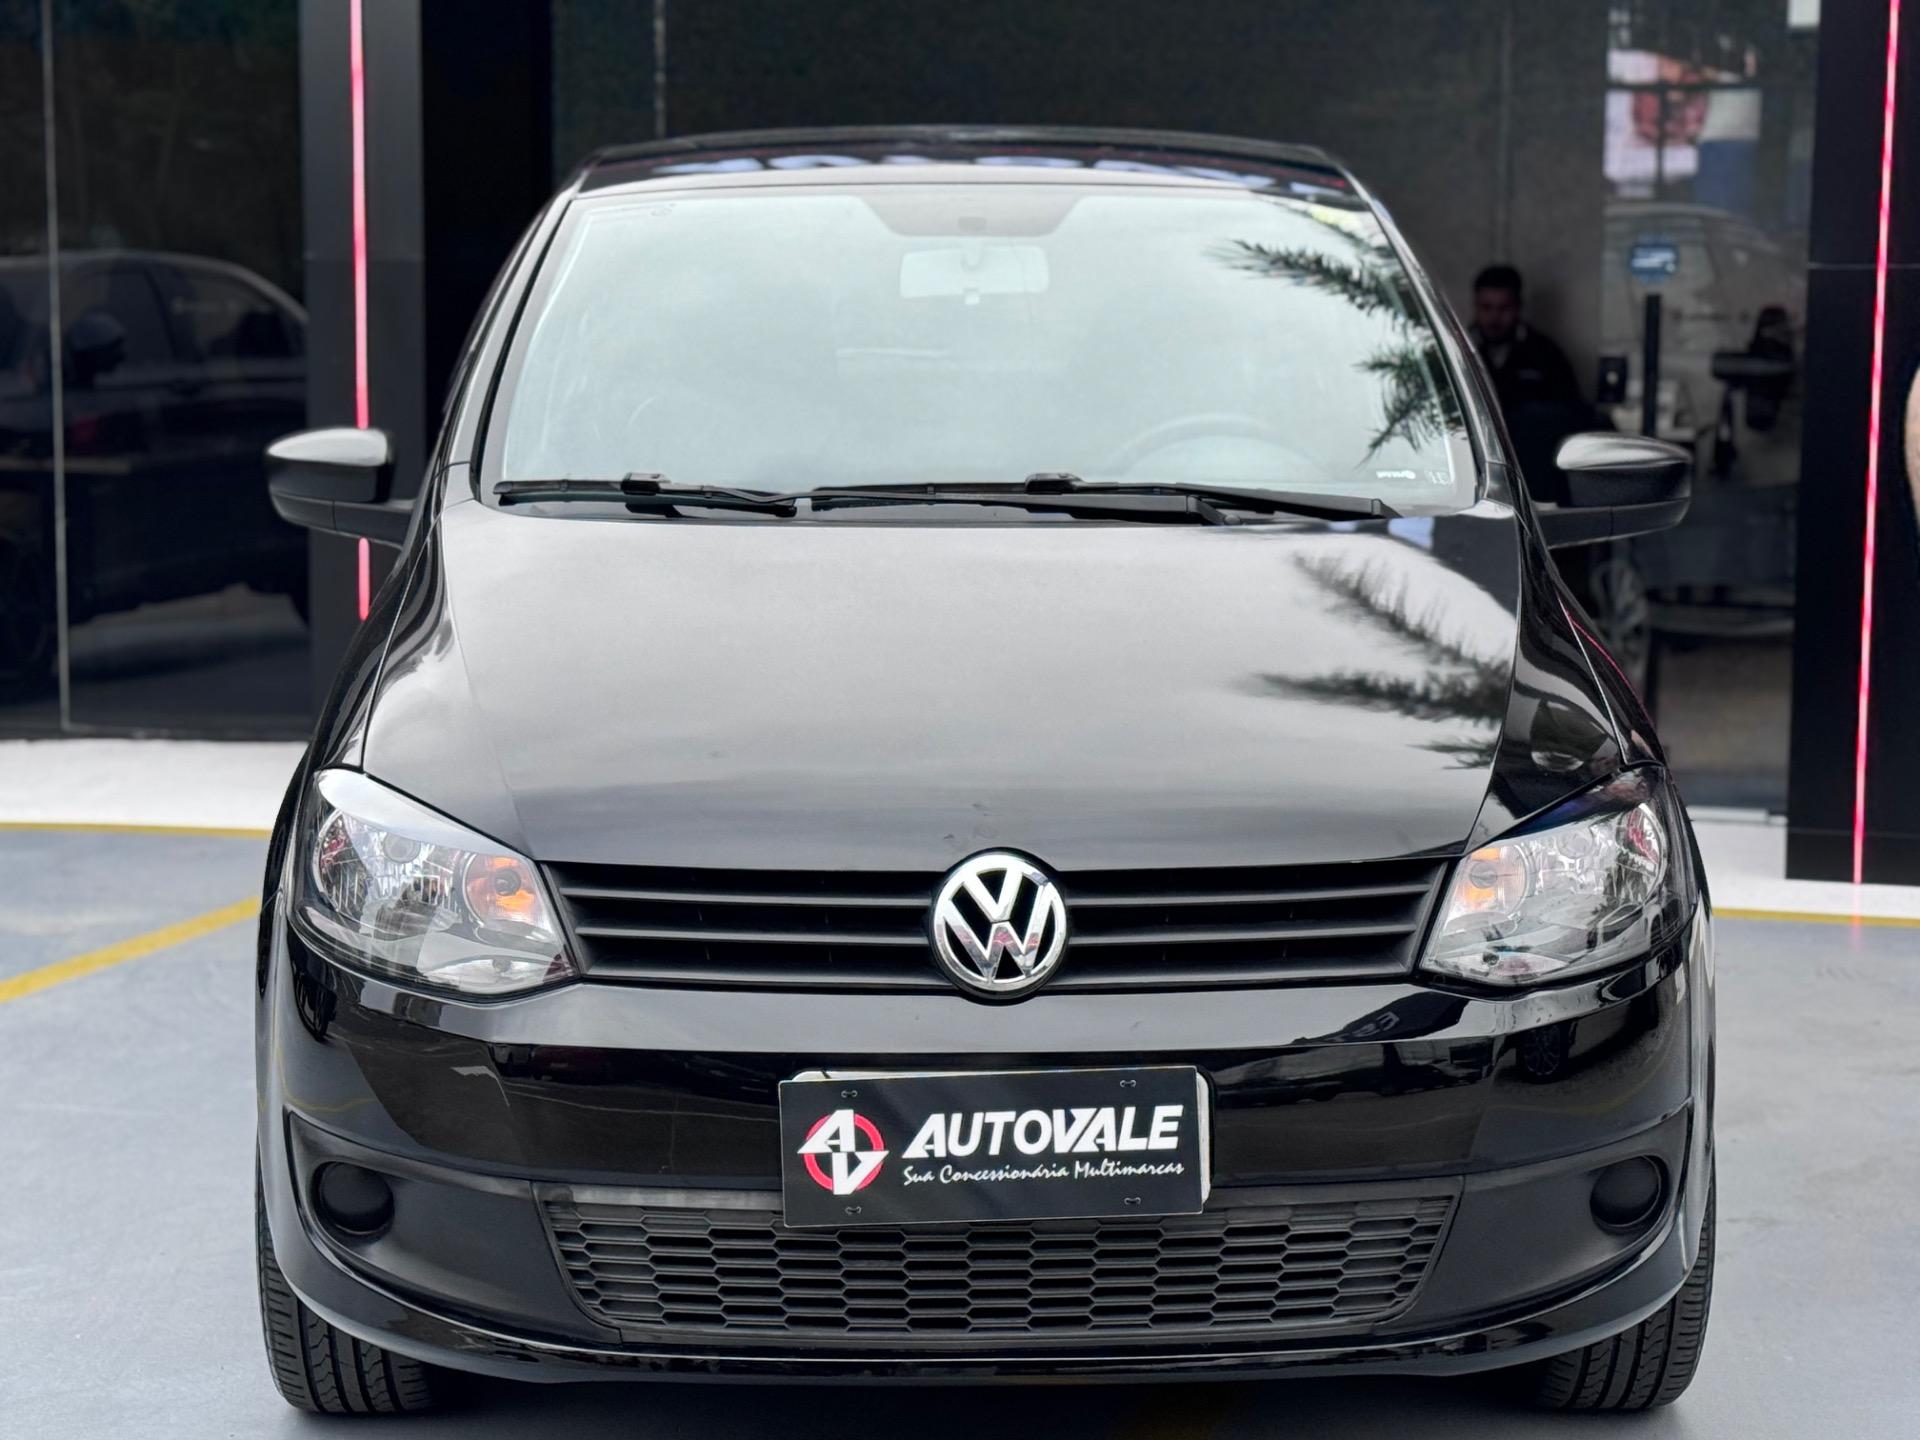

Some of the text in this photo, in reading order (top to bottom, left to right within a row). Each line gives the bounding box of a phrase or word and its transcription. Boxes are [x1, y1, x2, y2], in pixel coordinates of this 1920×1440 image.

[934, 854, 1067, 991] VW
[901, 1104, 1184, 1159] AUTOVALE
[903, 1157, 1185, 1186] Sua Concessionária Multimarcas
